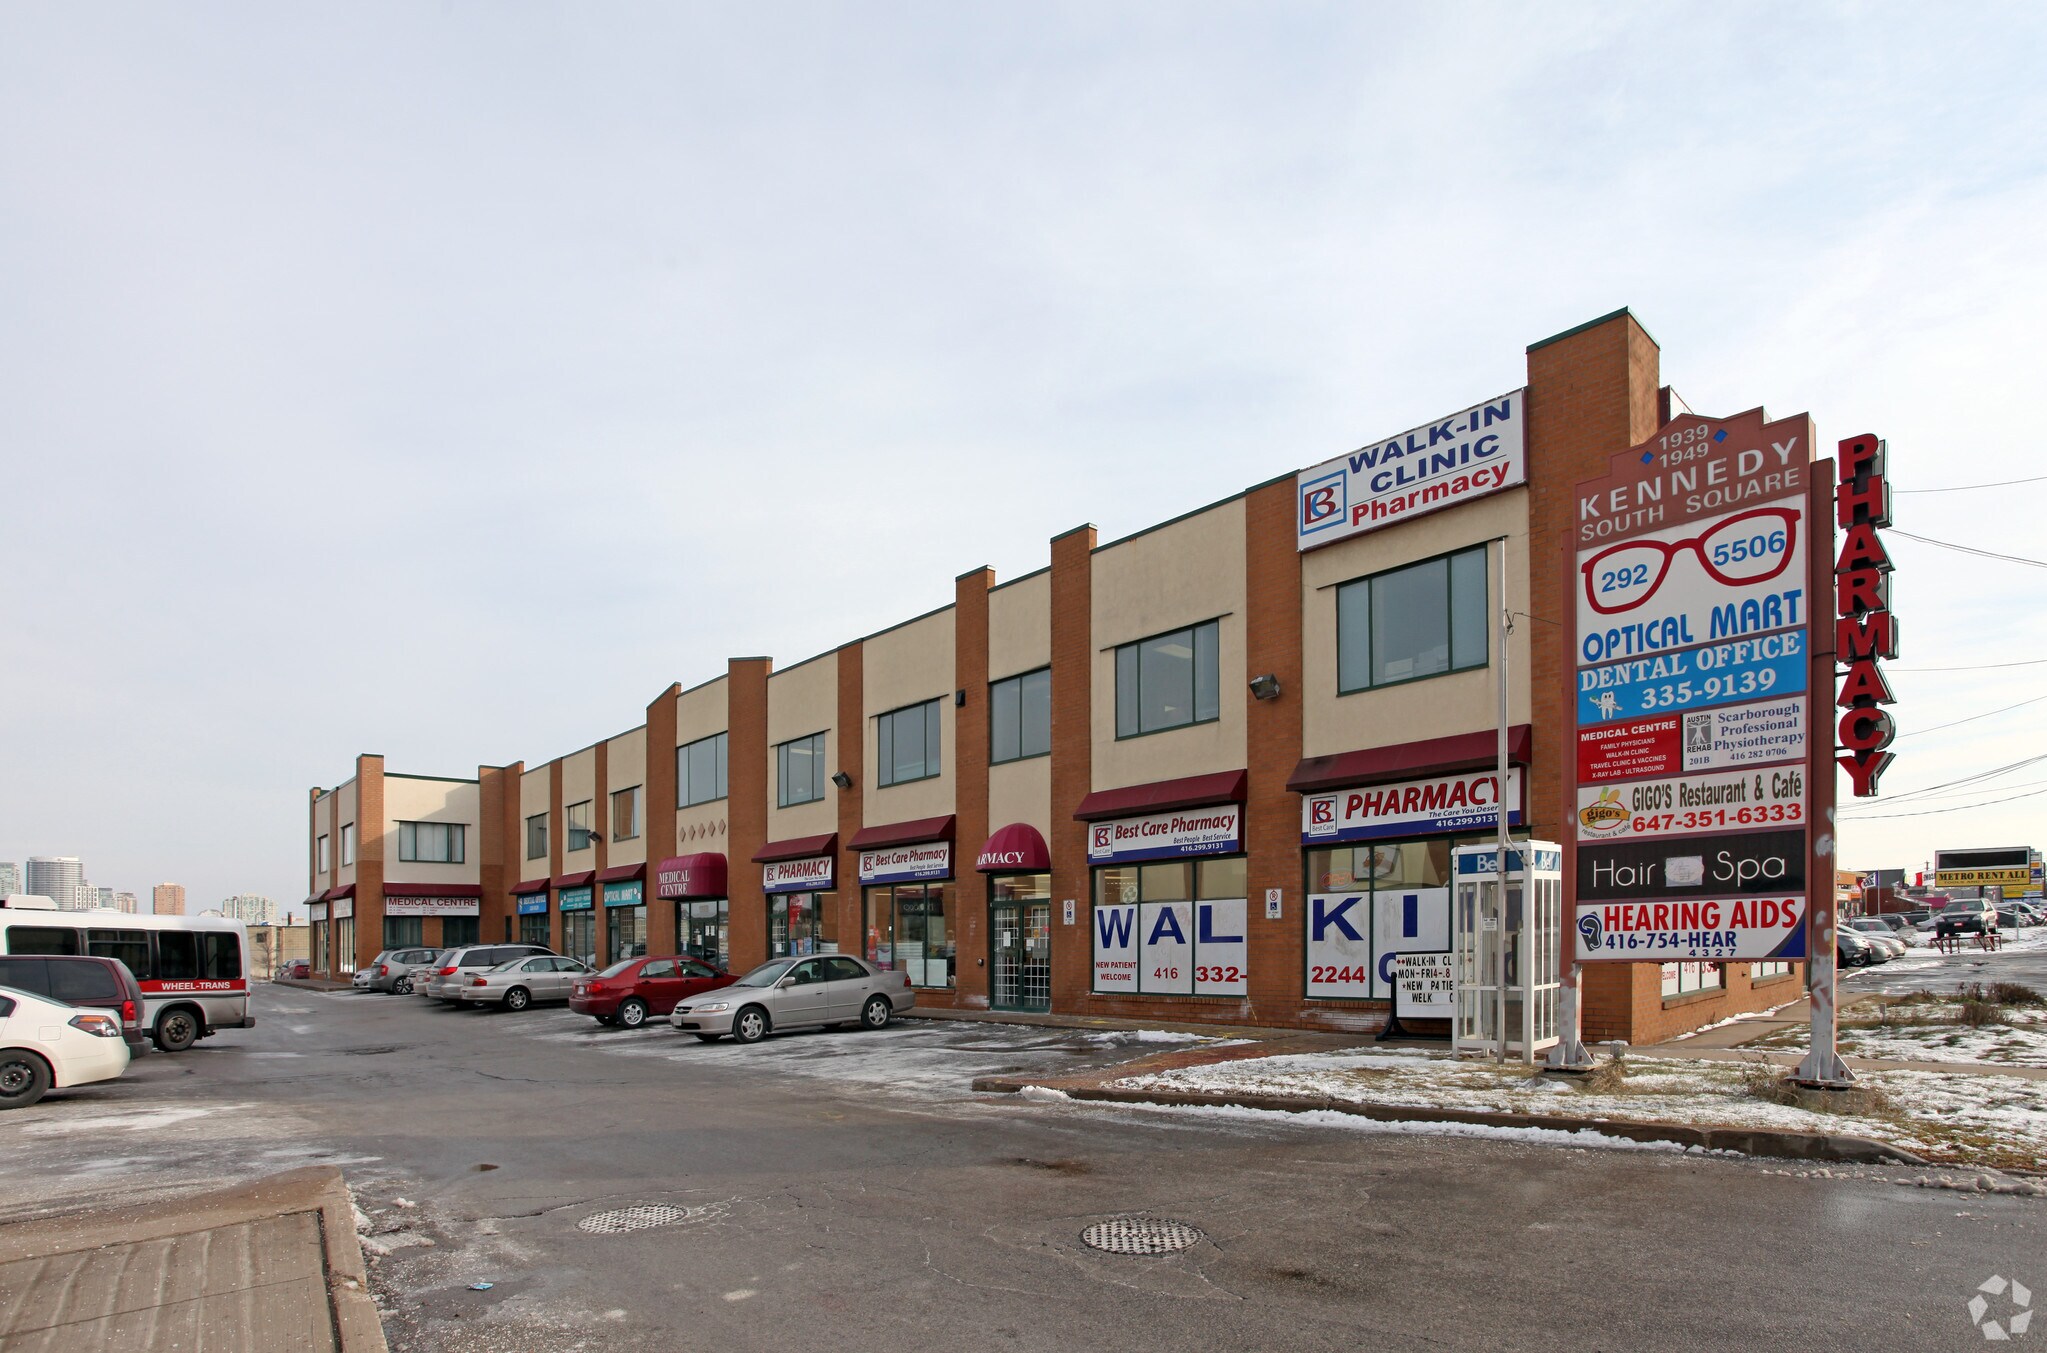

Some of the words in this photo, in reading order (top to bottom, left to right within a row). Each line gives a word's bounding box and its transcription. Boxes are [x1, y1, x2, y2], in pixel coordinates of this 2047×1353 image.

[1348, 398, 1511, 474] WALK-IN
[1659, 424, 1709, 450] 1939
[1370, 434, 1500, 493] CLINIC
[1659, 442, 1709, 468] 1949
[1580, 436, 1798, 521] KENNEDY
[1352, 461, 1511, 526] Pharmacy
[1581, 504, 1664, 542] SOUTH
[1686, 467, 1800, 514] SQUARE
[1601, 563, 1648, 592] 292
[1713, 530, 1786, 566] 5506
[1836, 433, 1898, 797] PHARMACY
[1583, 614, 1693, 662] OPTICAL
[1709, 588, 1802, 640] MART
[1581, 653, 1688, 692] DENTAL
[1696, 631, 1801, 672] OFFICE
[1641, 667, 1776, 709] 335-9139
[1686, 714, 1711, 723] AUSTIN
[1718, 703, 1800, 724] Scarborough
[1580, 728, 1628, 741] MEDICAL
[1631, 720, 1676, 734] CENTRE
[1720, 717, 1798, 736] Professional
[1600, 741, 1620, 750] FAMILY
[1621, 737, 1655, 747] PHYSICIANS
[1686, 744, 1712, 753] REHAB
[1714, 732, 1805, 751] Physiotherapy
[1590, 762, 1611, 770] TRAVEL
[1612, 758, 1631, 767] CLINIC
[1637, 754, 1666, 763] VACCINES
[1605, 750, 1630, 759] WALK-IN
[1630, 747, 1649, 756] CLINIC
[1689, 756, 1710, 766] 201B
[1730, 750, 1746, 760] 416
[1748, 749, 1763, 759] 282
[1765, 747, 1787, 757] 0706
[1592, 771, 1608, 779] X-RAY
[1609, 768, 1621, 777] LAB
[1625, 764, 1665, 774] ULTRASOUND
[1632, 783, 1673, 812] GIGO'S
[1679, 777, 1747, 808] Restaurant
[1754, 774, 1764, 801] &
[1772, 770, 1802, 800] Café
[1443, 809, 1460, 817] Care
[1461, 807, 1476, 815] You
[1586, 808, 1620, 822] gigo's
[1632, 803, 1802, 833] 647-351-6333
[1114, 824, 1139, 840] Best
[1142, 821, 1168, 837] Care
[1171, 815, 1236, 833] Pharmacy
[1312, 824, 1323, 832] Best
[1323, 823, 1335, 831] Care
[1582, 828, 1611, 838] restaurant
[1174, 836, 1184, 844] Best
[1184, 835, 1200, 843] People
[1213, 832, 1231, 841] Service
[876, 854, 891, 866] Best
[892, 852, 908, 864] Care
[909, 847, 947, 862] Pharmacy
[1181, 842, 1223, 853] 416.299.9131
[658, 869, 690, 885] MEDICAL
[778, 859, 830, 879] PHARMACY
[1593, 859, 1656, 888] Hair
[1713, 850, 1786, 887] Spa
[1938, 872, 1974, 880] METRO
[1977, 871, 2005, 879] RENT
[2007, 870, 2027, 879] ALL
[660, 881, 688, 896] CENTRE
[388, 897, 434, 906] MEDICAL
[437, 898, 476, 906] CENTRE
[1604, 902, 1721, 932] HEARING
[1729, 899, 1797, 929] AIDS
[1605, 931, 1737, 949] 416-754-HEAR
[1405, 956, 1436, 966] WALK-IN
[1154, 967, 1179, 979] 416
[1311, 965, 1366, 983] 2244
[161, 981, 231, 991] WHEEL-TRANS
[1406, 981, 1423, 990] NEW
